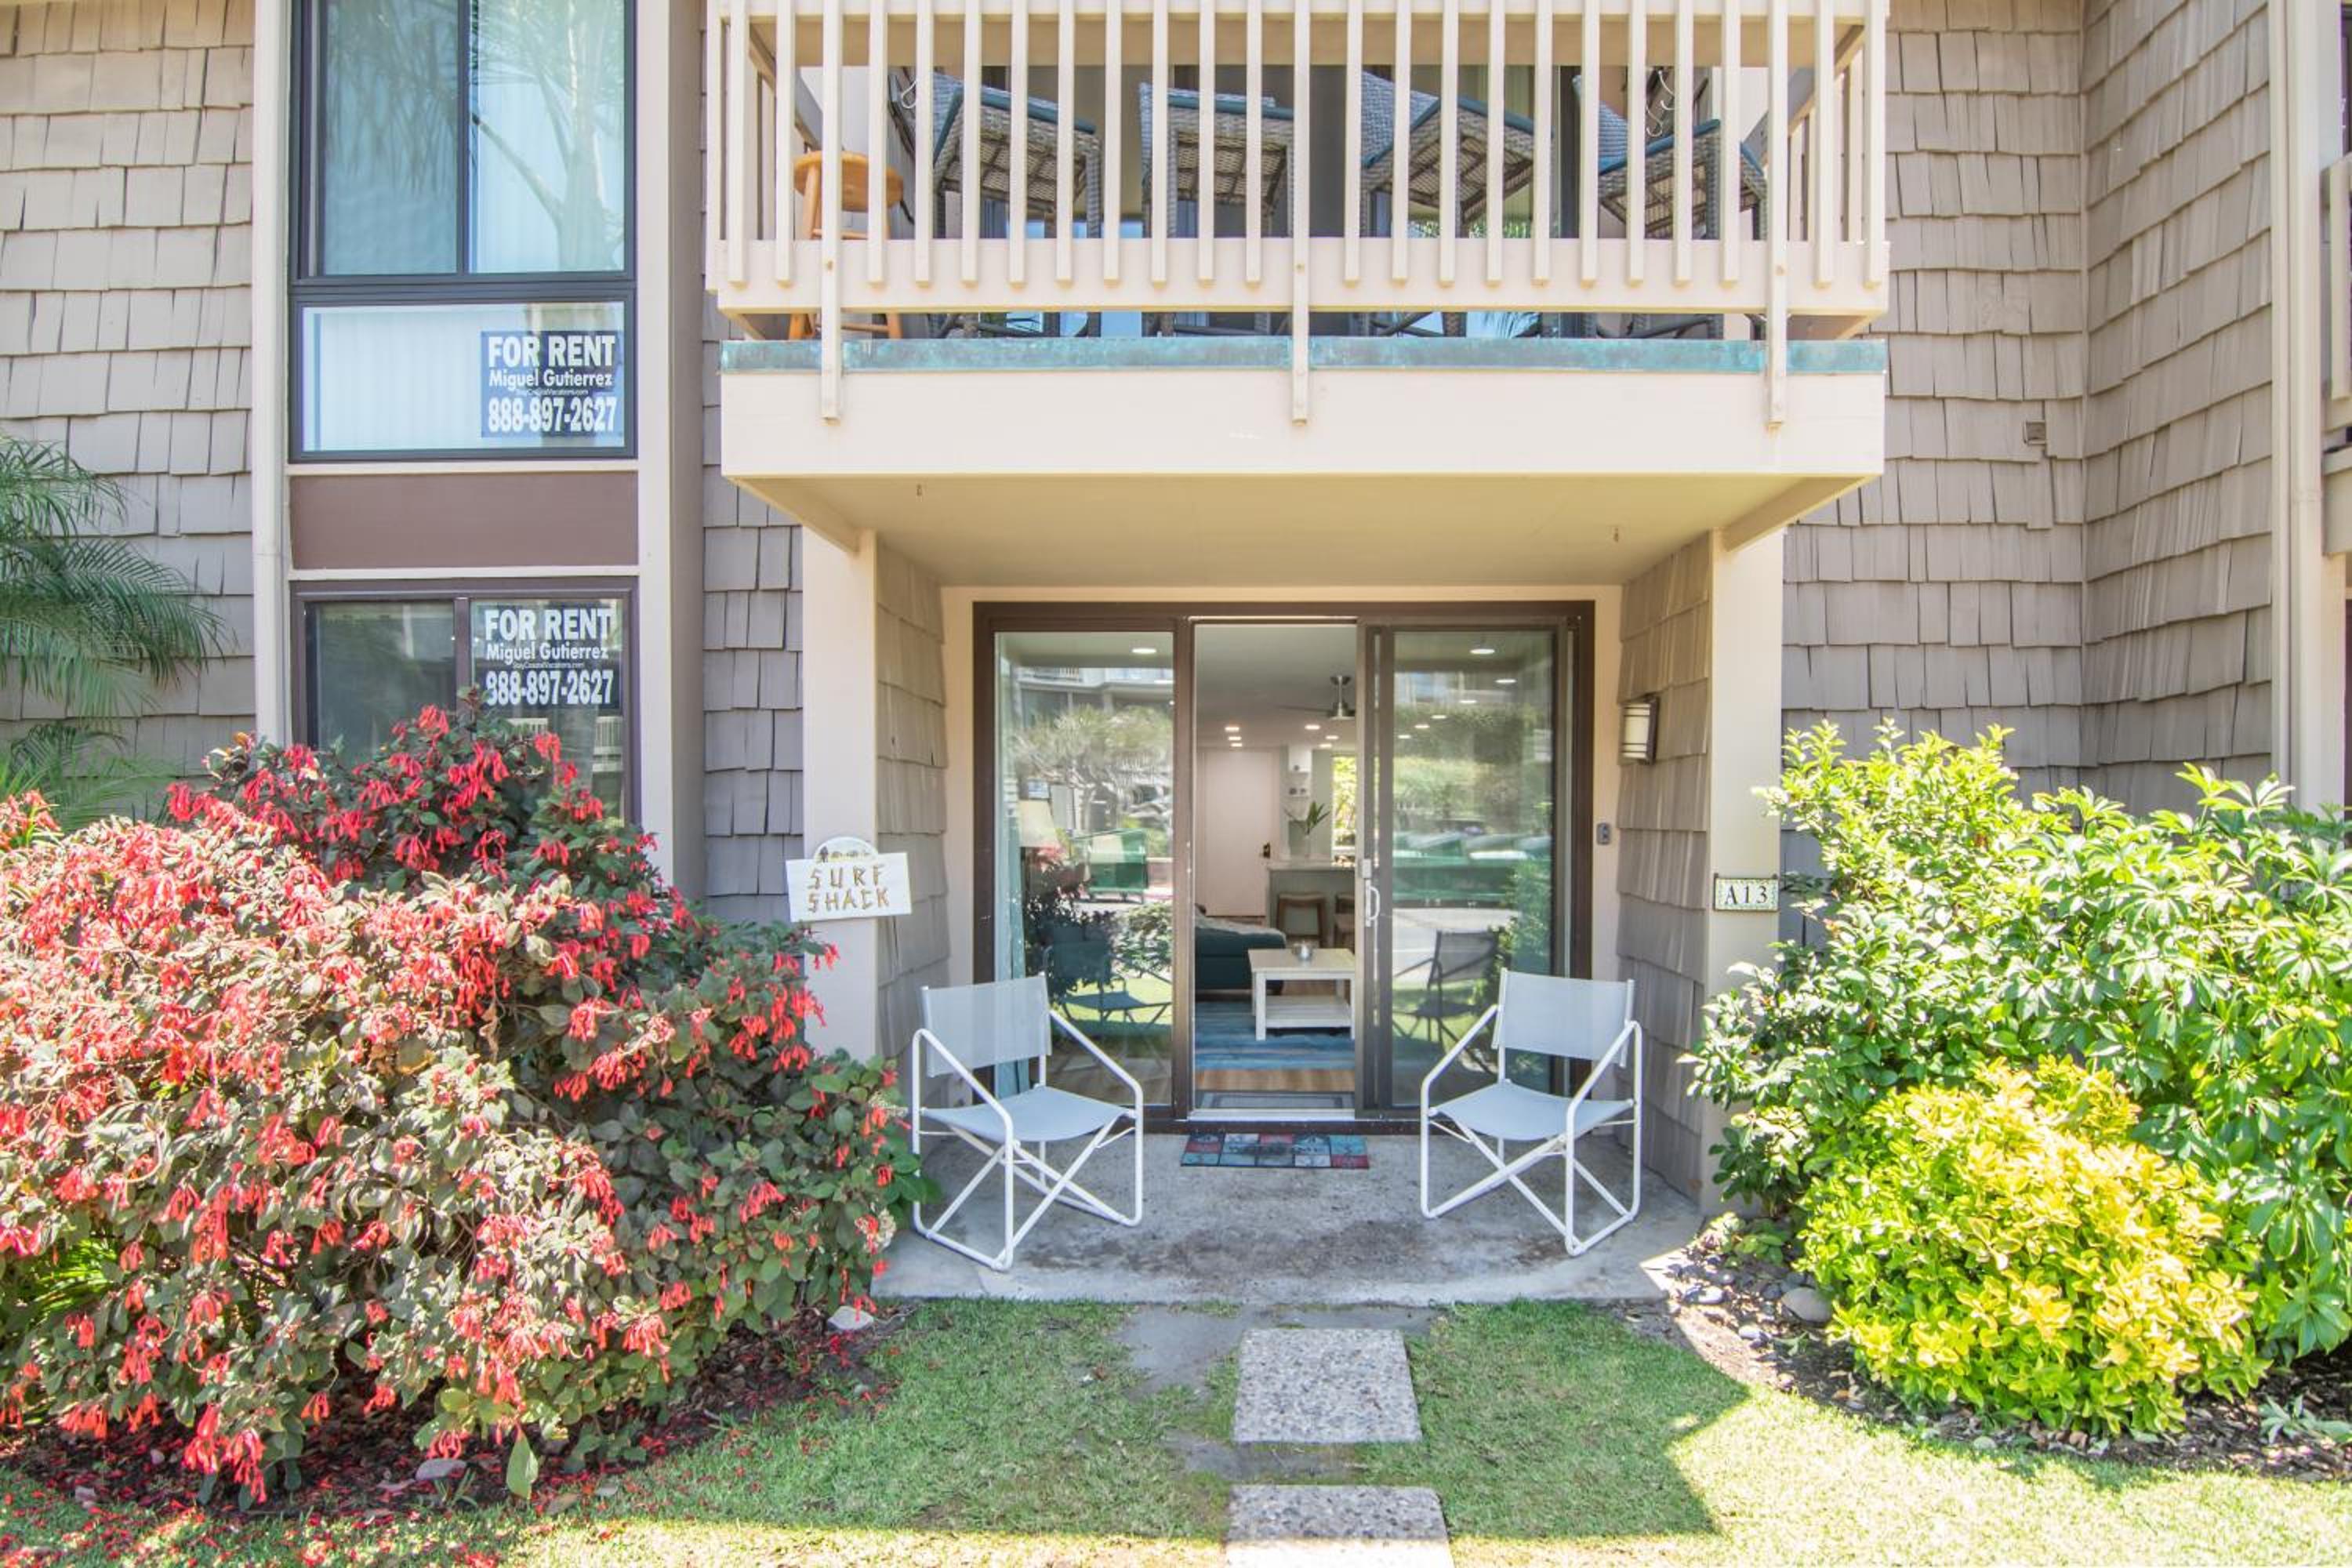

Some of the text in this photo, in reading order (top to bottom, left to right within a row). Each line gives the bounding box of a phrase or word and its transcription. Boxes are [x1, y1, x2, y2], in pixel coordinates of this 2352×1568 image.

[488, 335, 615, 368] FOR RENT
[488, 368, 612, 392] Miguel Gutierrez
[488, 396, 618, 432] 888-897-2627
[485, 608, 612, 641] FOR RENT
[486, 641, 609, 665] Miguel Gutierrez
[485, 670, 614, 706] 888-897-2627
[808, 864, 887, 889] SURF
[808, 887, 890, 913] SHACK
[1725, 885, 1768, 905] A13
